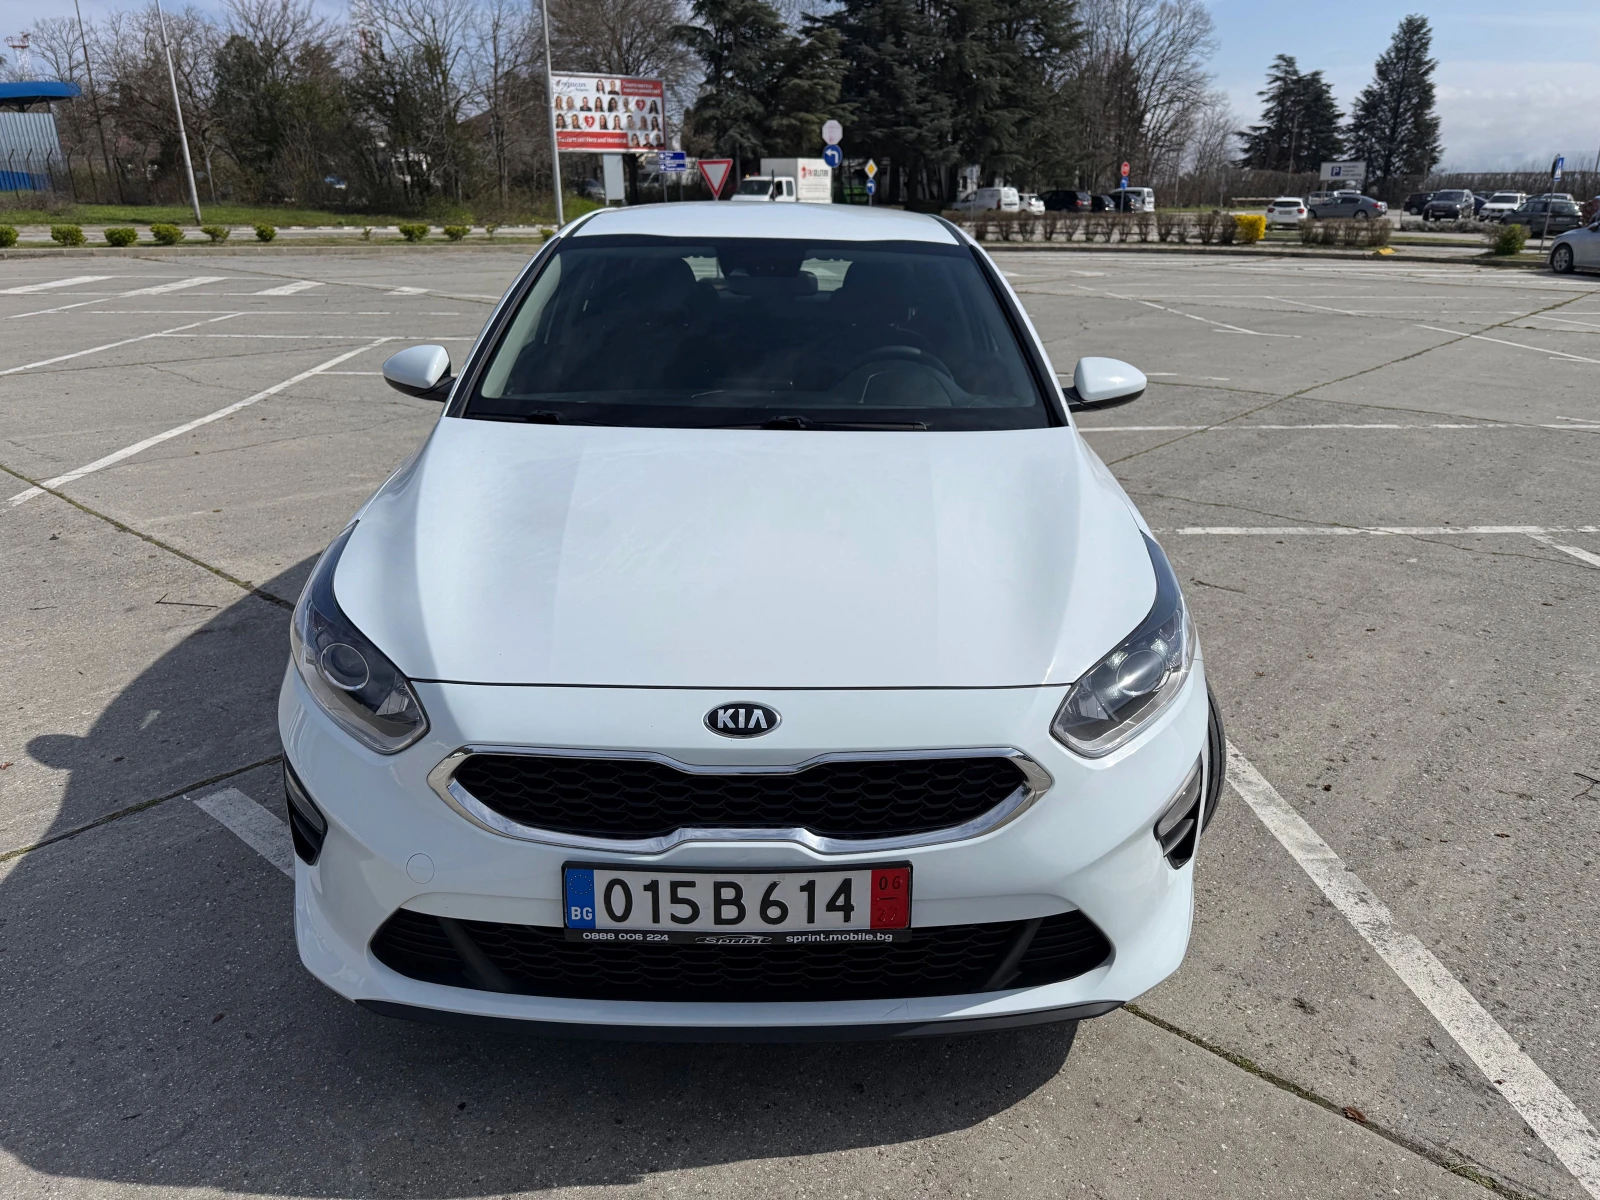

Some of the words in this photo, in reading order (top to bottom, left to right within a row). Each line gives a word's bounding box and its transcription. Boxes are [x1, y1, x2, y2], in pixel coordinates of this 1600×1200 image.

[717, 708, 768, 729] KIA
[878, 875, 901, 891] 06
[603, 877, 855, 926] 015B614
[571, 906, 593, 920] BG
[582, 932, 615, 940] 0888
[618, 933, 643, 941] 006
[785, 932, 893, 943] sprint.mobile.bg
